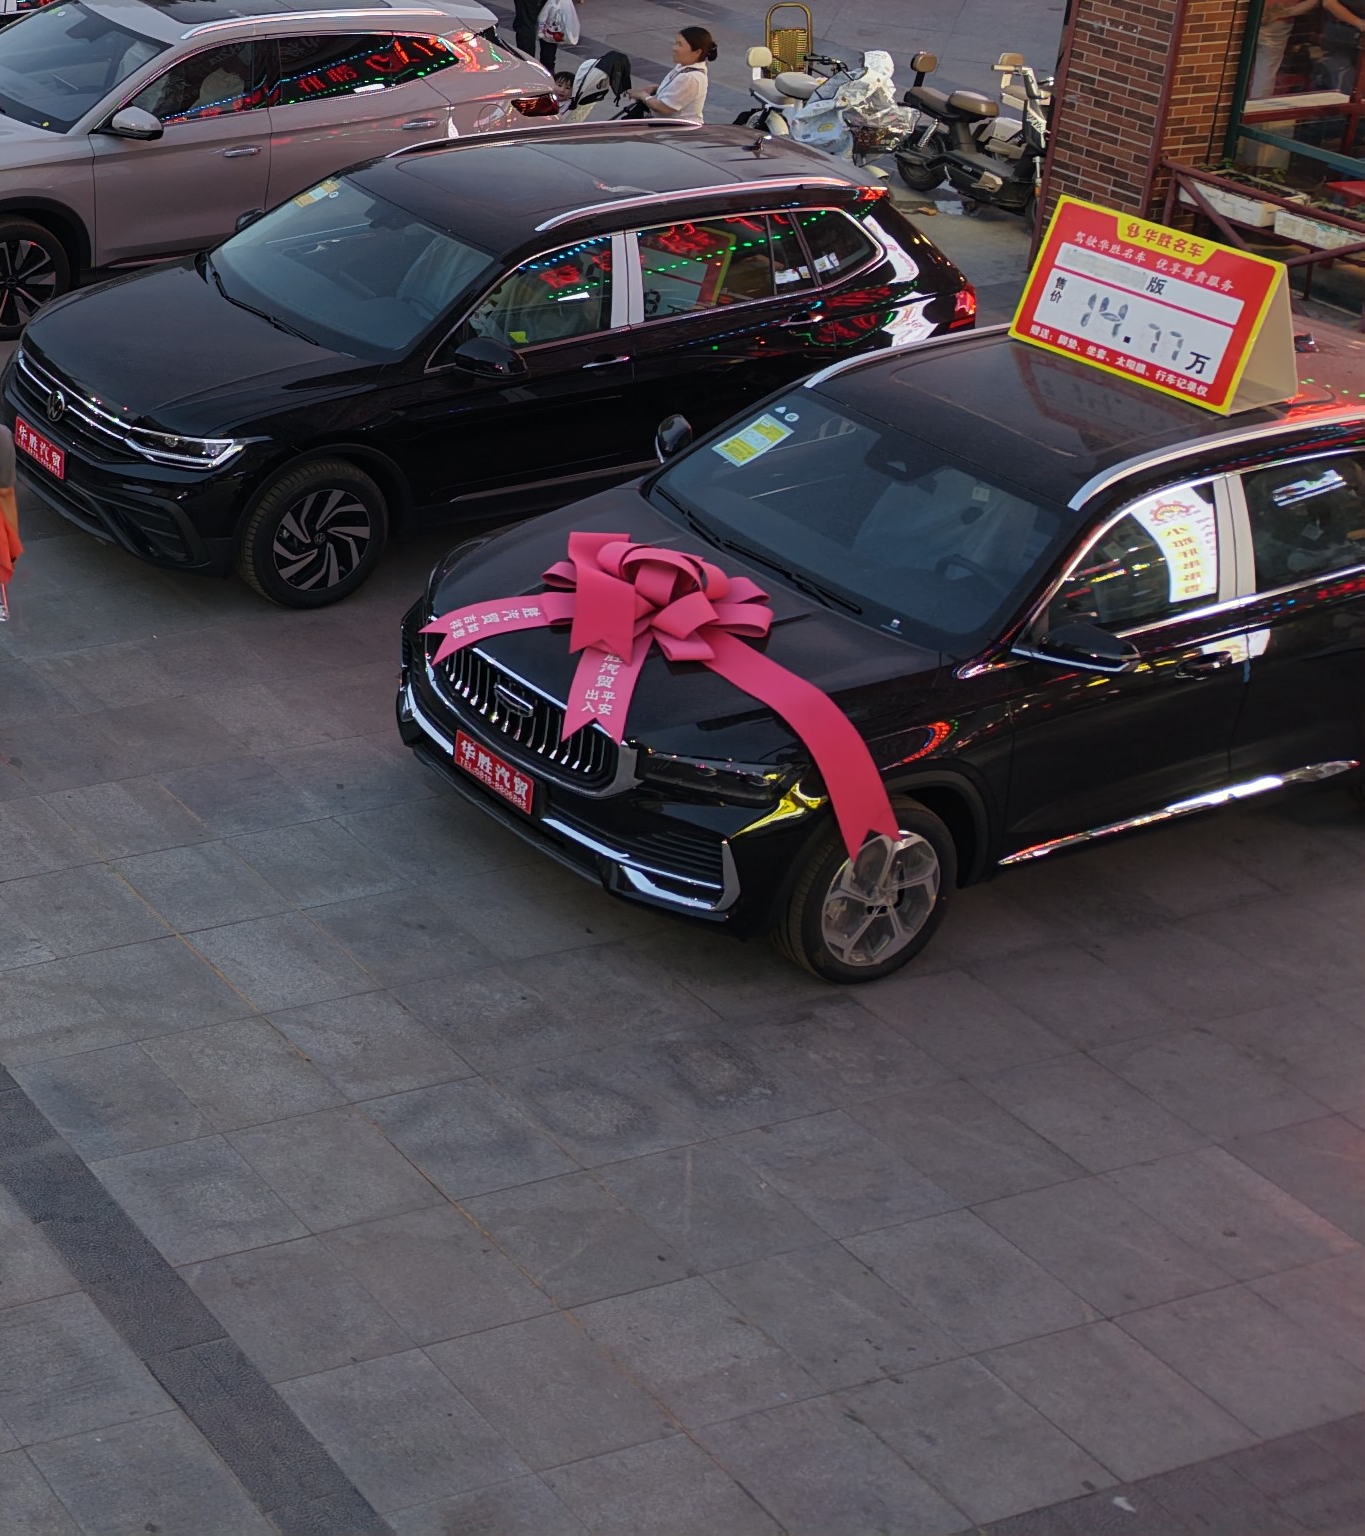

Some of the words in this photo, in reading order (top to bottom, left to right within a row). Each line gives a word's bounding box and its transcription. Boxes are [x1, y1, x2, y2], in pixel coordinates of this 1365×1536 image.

[1073, 231, 1148, 264] 驾驶华胜名车
[1143, 227, 1205, 259] 华胜名车
[1049, 275, 1068, 304] 售价
[1145, 276, 1168, 296] 版
[1185, 351, 1211, 375] 万
[19, 424, 61, 470] 华胜汽贸
[461, 739, 529, 801] 华胜汽贸
